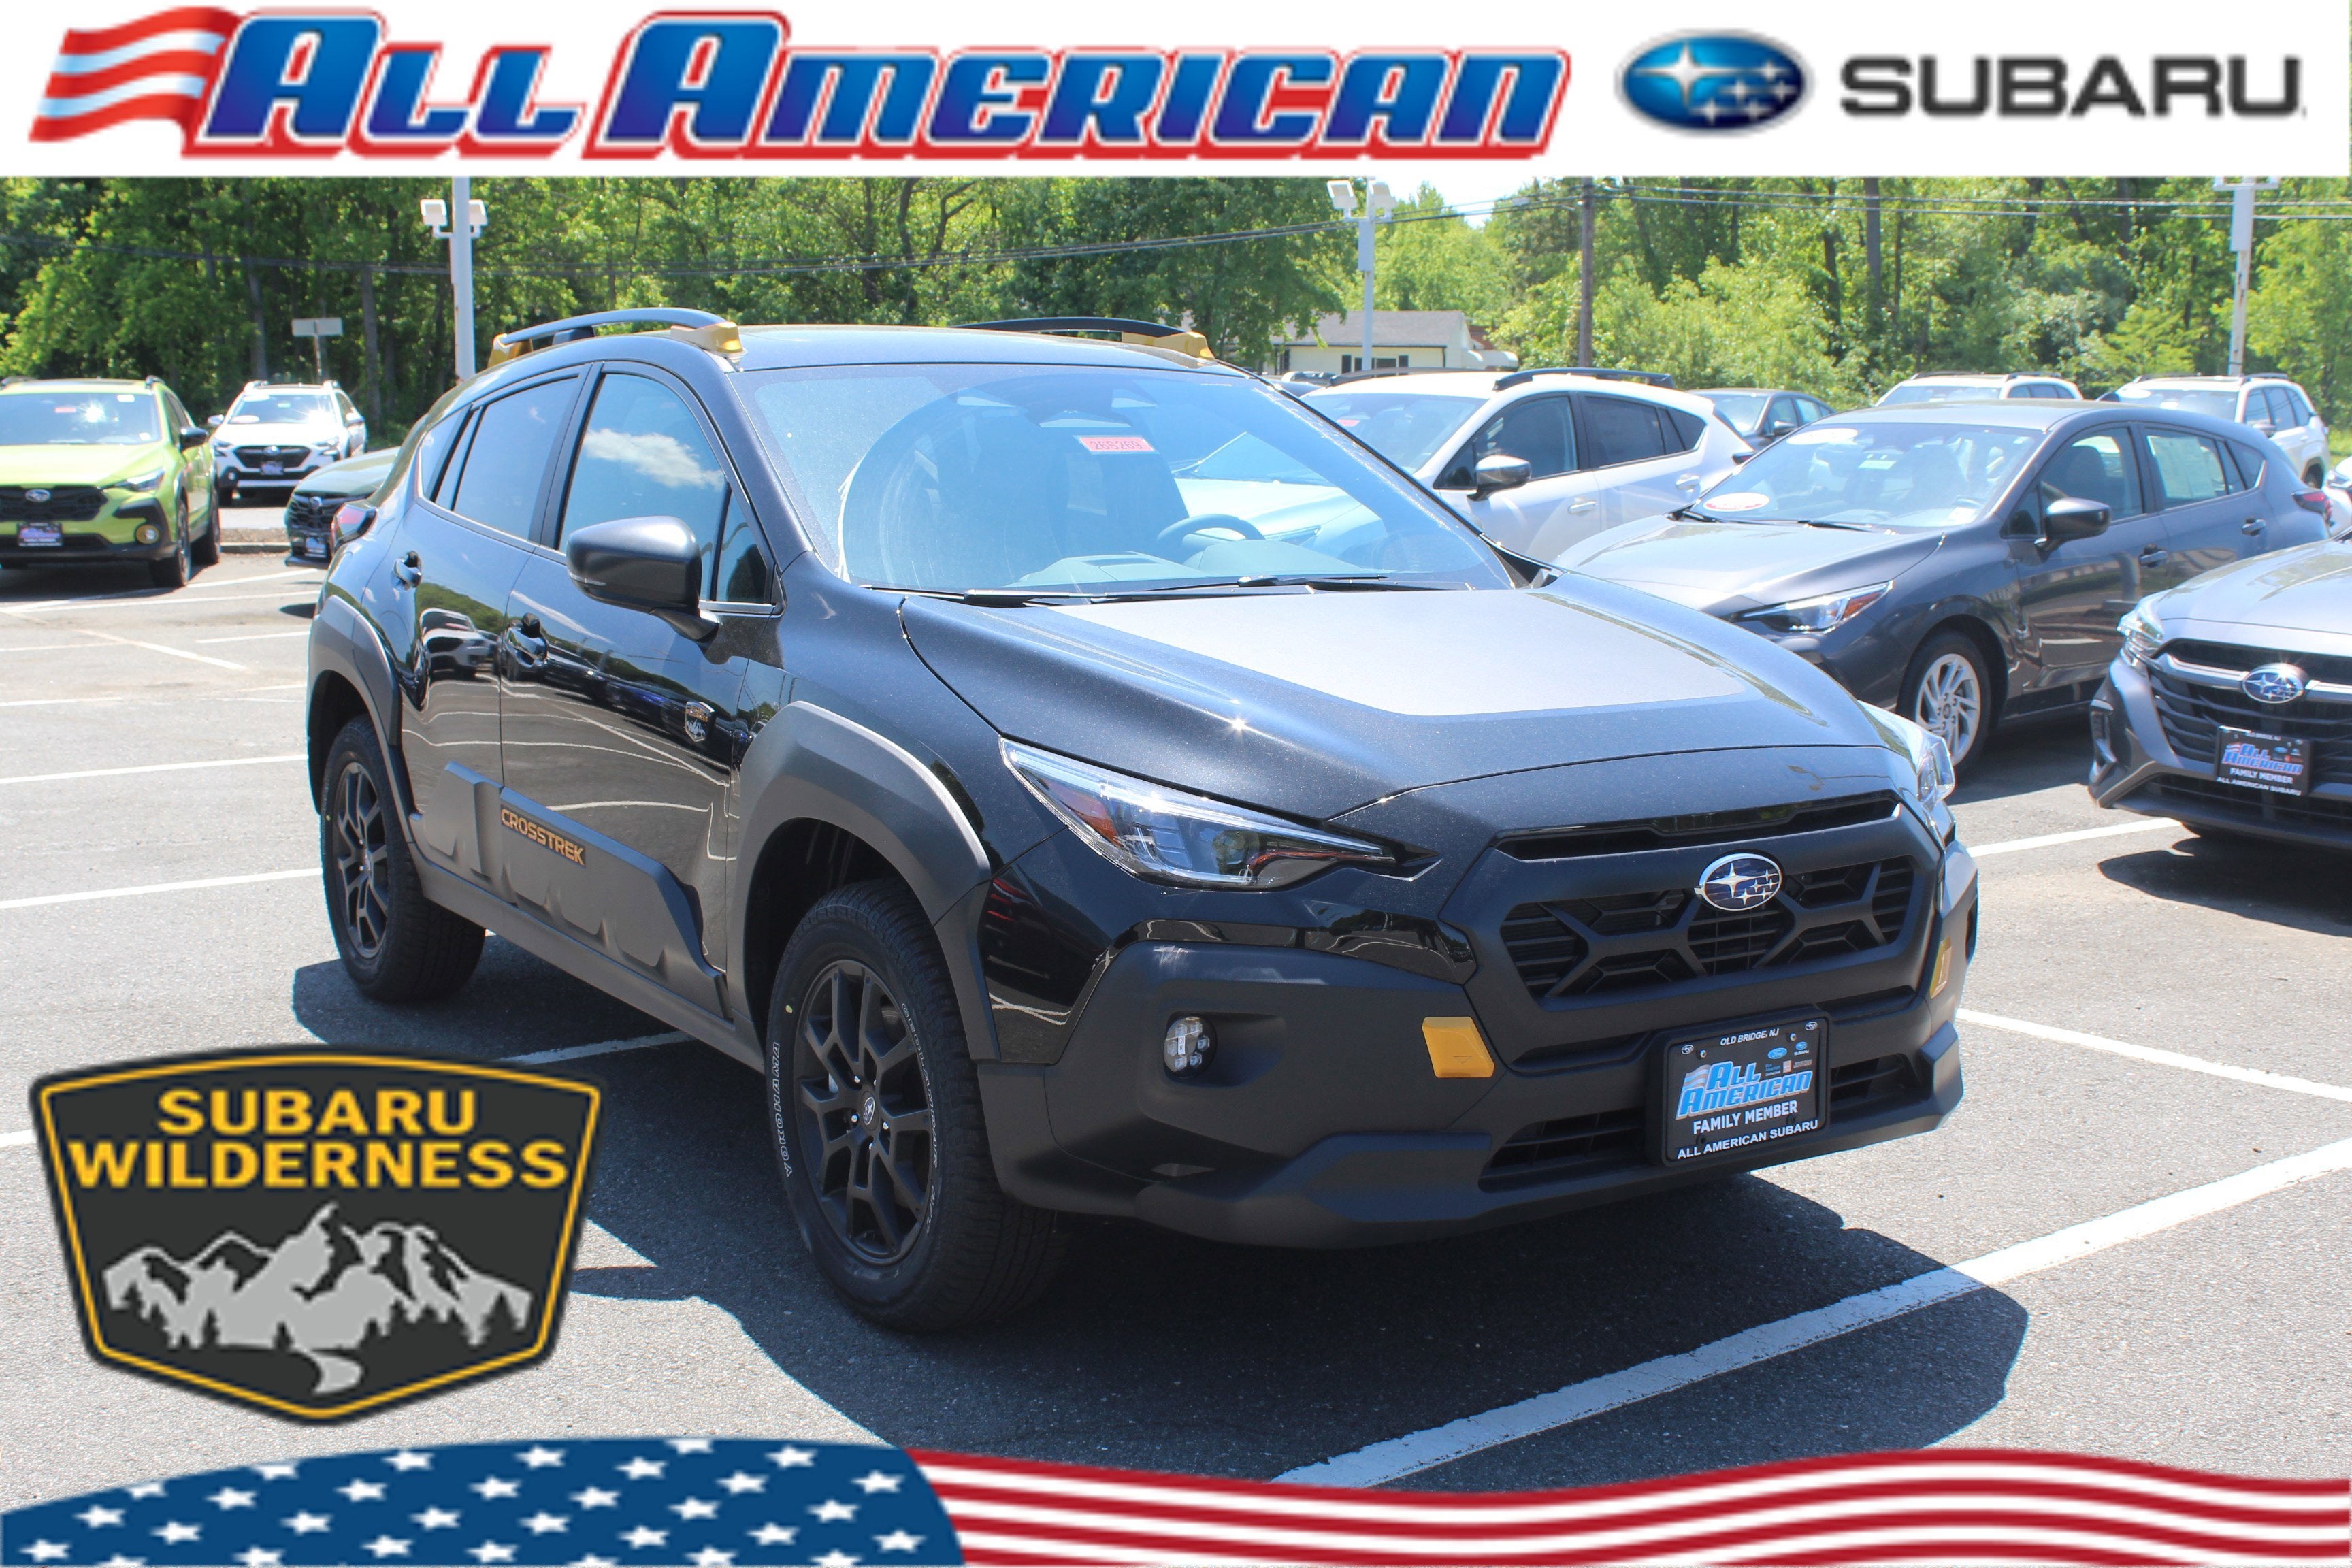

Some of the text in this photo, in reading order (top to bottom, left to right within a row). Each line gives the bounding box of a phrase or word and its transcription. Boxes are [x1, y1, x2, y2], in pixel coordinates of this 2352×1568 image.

[2216, 777, 2302, 796] ALL AMERICAN SUBARU
[2230, 768, 2293, 784] FAMILY MEMBER
[501, 808, 585, 866] CROSSTREK
[1720, 1036, 1736, 1046] OLD
[1769, 1028, 1779, 1037] NJ
[1705, 1060, 1763, 1090] ALL
[772, 1041, 793, 1177] YOKOHAMA
[1675, 1071, 1813, 1120] AMERICAN
[1693, 1100, 1798, 1135] FAMILY MEMBER
[1677, 1120, 1818, 1160] ALL AMERICAN SUBARU
